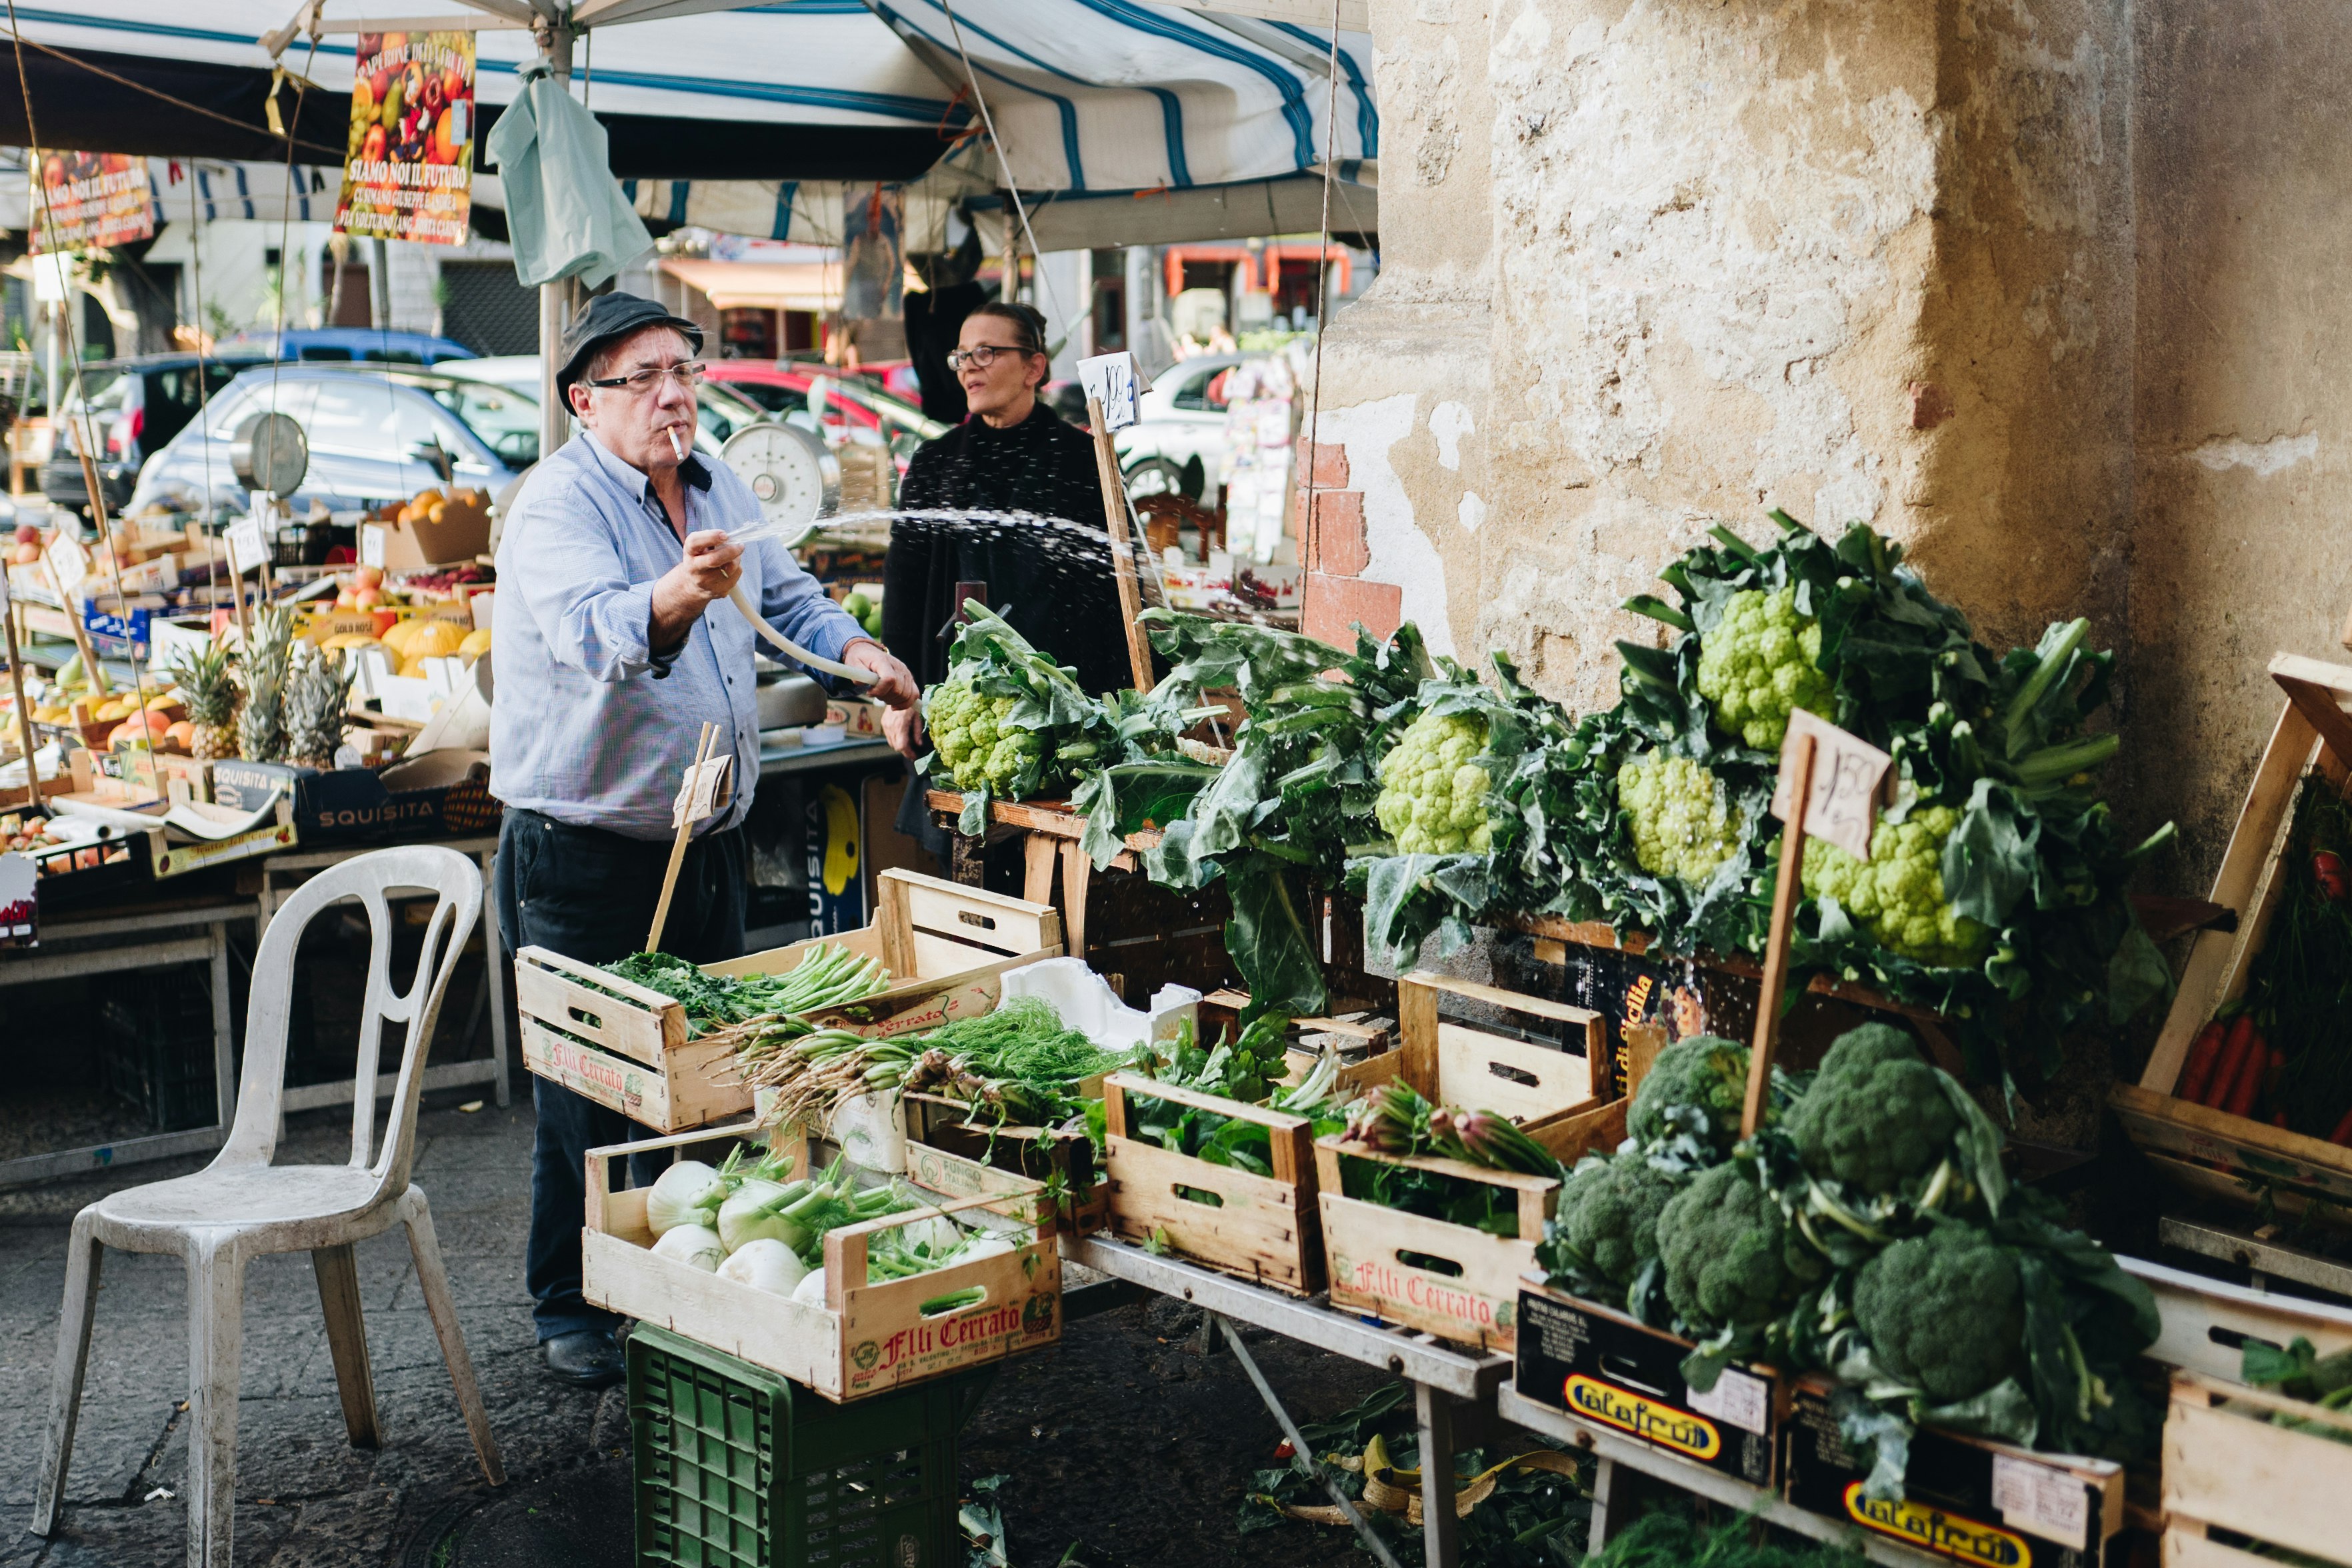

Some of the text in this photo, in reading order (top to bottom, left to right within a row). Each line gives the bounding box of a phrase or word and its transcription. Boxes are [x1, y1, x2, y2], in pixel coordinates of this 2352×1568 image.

[349, 159, 467, 189] SIAMO NOI IL FUTURO
[355, 212, 394, 231] VOLTURNO
[334, 624, 353, 635] GOLD
[214, 767, 267, 789] SQUISITA
[319, 800, 433, 827] SQUISITA
[579, 1054, 623, 1091] Cerrato
[943, 1161, 981, 1181] FUNGO
[945, 1174, 983, 1193] ITALIANO
[1407, 1276, 1491, 1324] Cerrato
[879, 1324, 932, 1371] F.lli
[940, 1307, 1019, 1348] Cerrato
